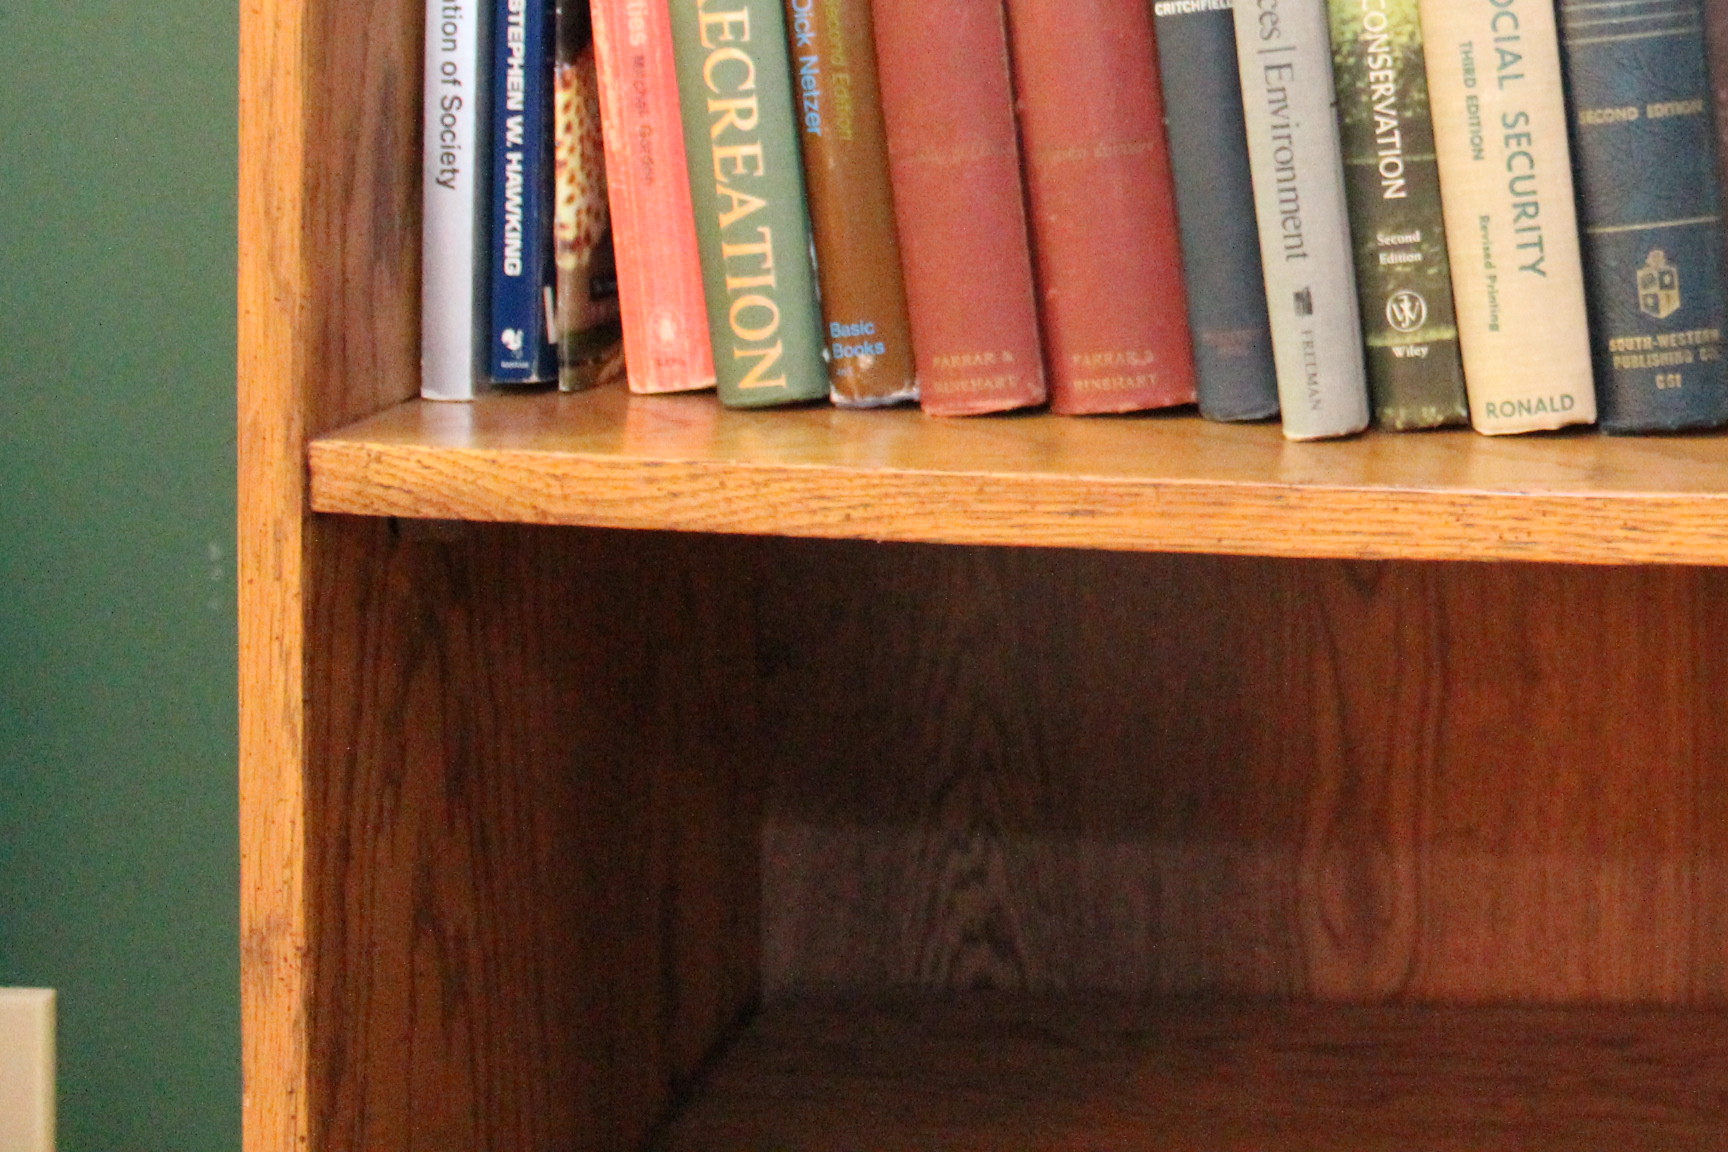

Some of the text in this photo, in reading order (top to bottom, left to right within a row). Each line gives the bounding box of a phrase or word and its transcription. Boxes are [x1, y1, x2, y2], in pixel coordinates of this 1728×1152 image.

[440, 62, 464, 86] of
[798, 55, 822, 136] Netzer
[830, 70, 854, 140] Edition
[435, 95, 463, 189] Society
[504, 115, 525, 146] W.
[1263, 62, 1311, 263] Environment
[1459, 40, 1502, 332] THIRD EDITION Revised Printing
[1500, 110, 1547, 277] SECURITY
[503, 151, 523, 276] HAWKING
[1376, 230, 1422, 246] Second
[1378, 251, 1423, 265] Edition
[830, 320, 876, 338] Basic
[1608, 329, 1720, 353] SOUTH-WESTERN
[832, 341, 886, 359] Books
[1392, 345, 1429, 358] Wiley
[1485, 394, 1575, 418] RONALD
